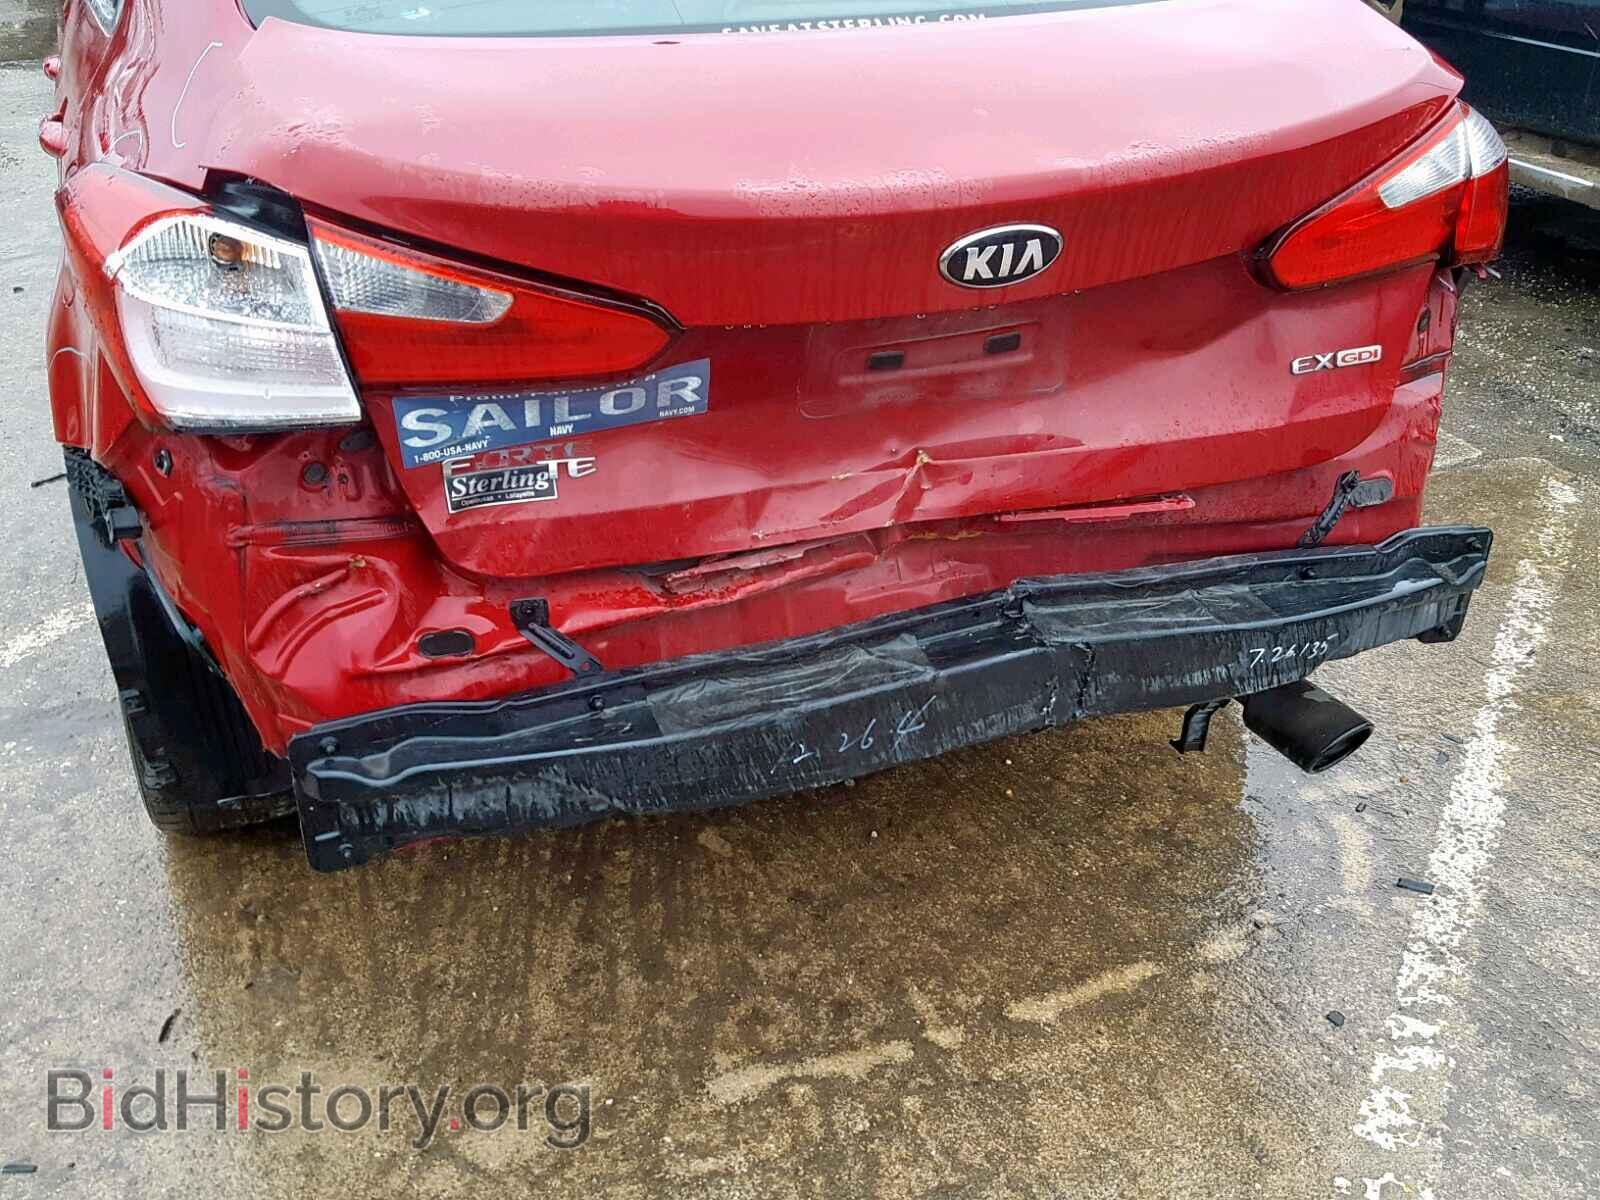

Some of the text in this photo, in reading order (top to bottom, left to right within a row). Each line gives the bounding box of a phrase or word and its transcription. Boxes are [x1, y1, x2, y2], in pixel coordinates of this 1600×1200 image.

[962, 238, 1045, 281] KIA
[1292, 347, 1381, 374] EX GDI
[400, 375, 702, 448] SAILOR
[659, 404, 695, 417] NAVY.COM
[550, 423, 574, 437] NAVY
[413, 438, 490, 464] 1-800-USA-NAVY
[451, 470, 549, 497] Sterling
